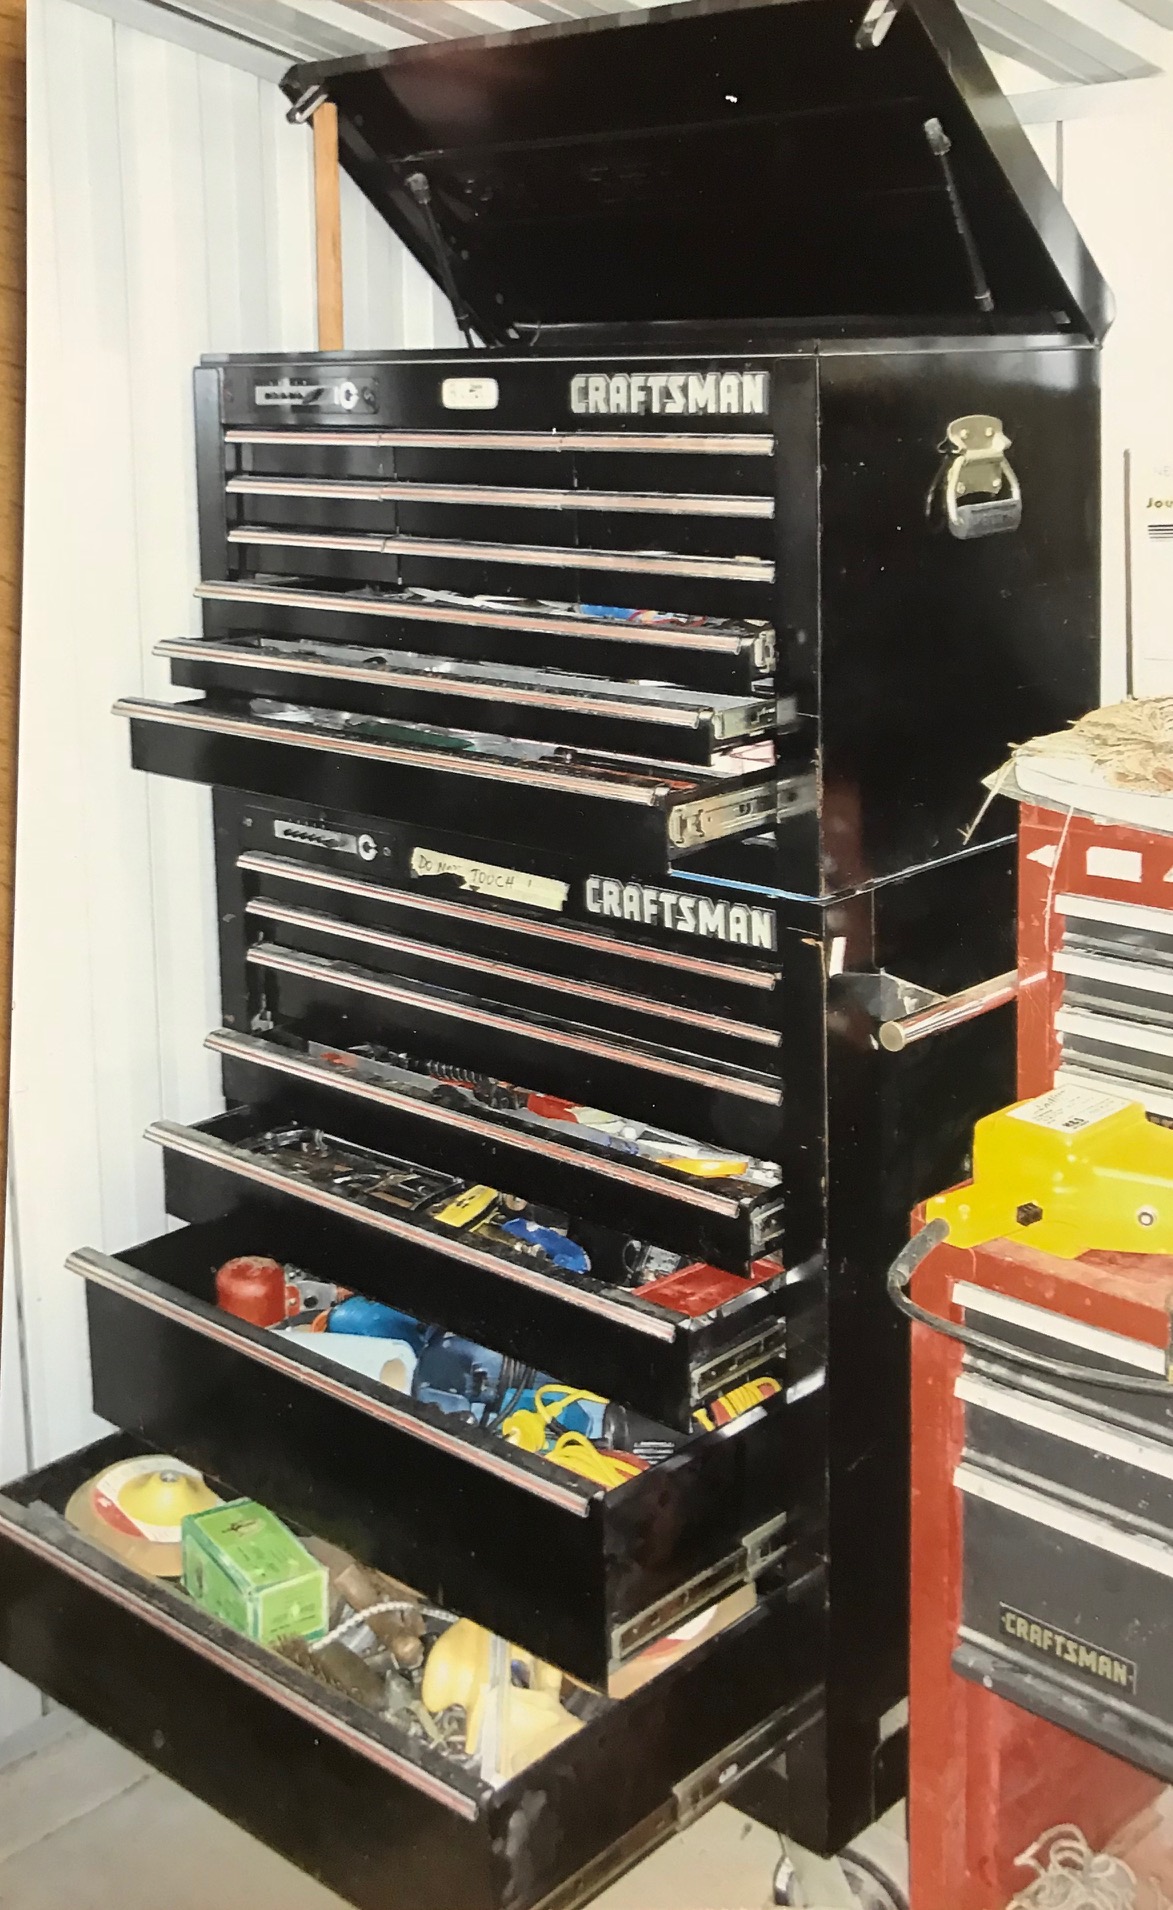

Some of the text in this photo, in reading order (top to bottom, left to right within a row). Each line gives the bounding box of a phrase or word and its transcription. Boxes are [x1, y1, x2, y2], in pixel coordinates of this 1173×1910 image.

[570, 371, 769, 415] CRAFTSMAN
[418, 854, 432, 871] DO
[586, 874, 777, 951] CRAFTSMAN
[1004, 1612, 1128, 1686] CRAFTSMAN
